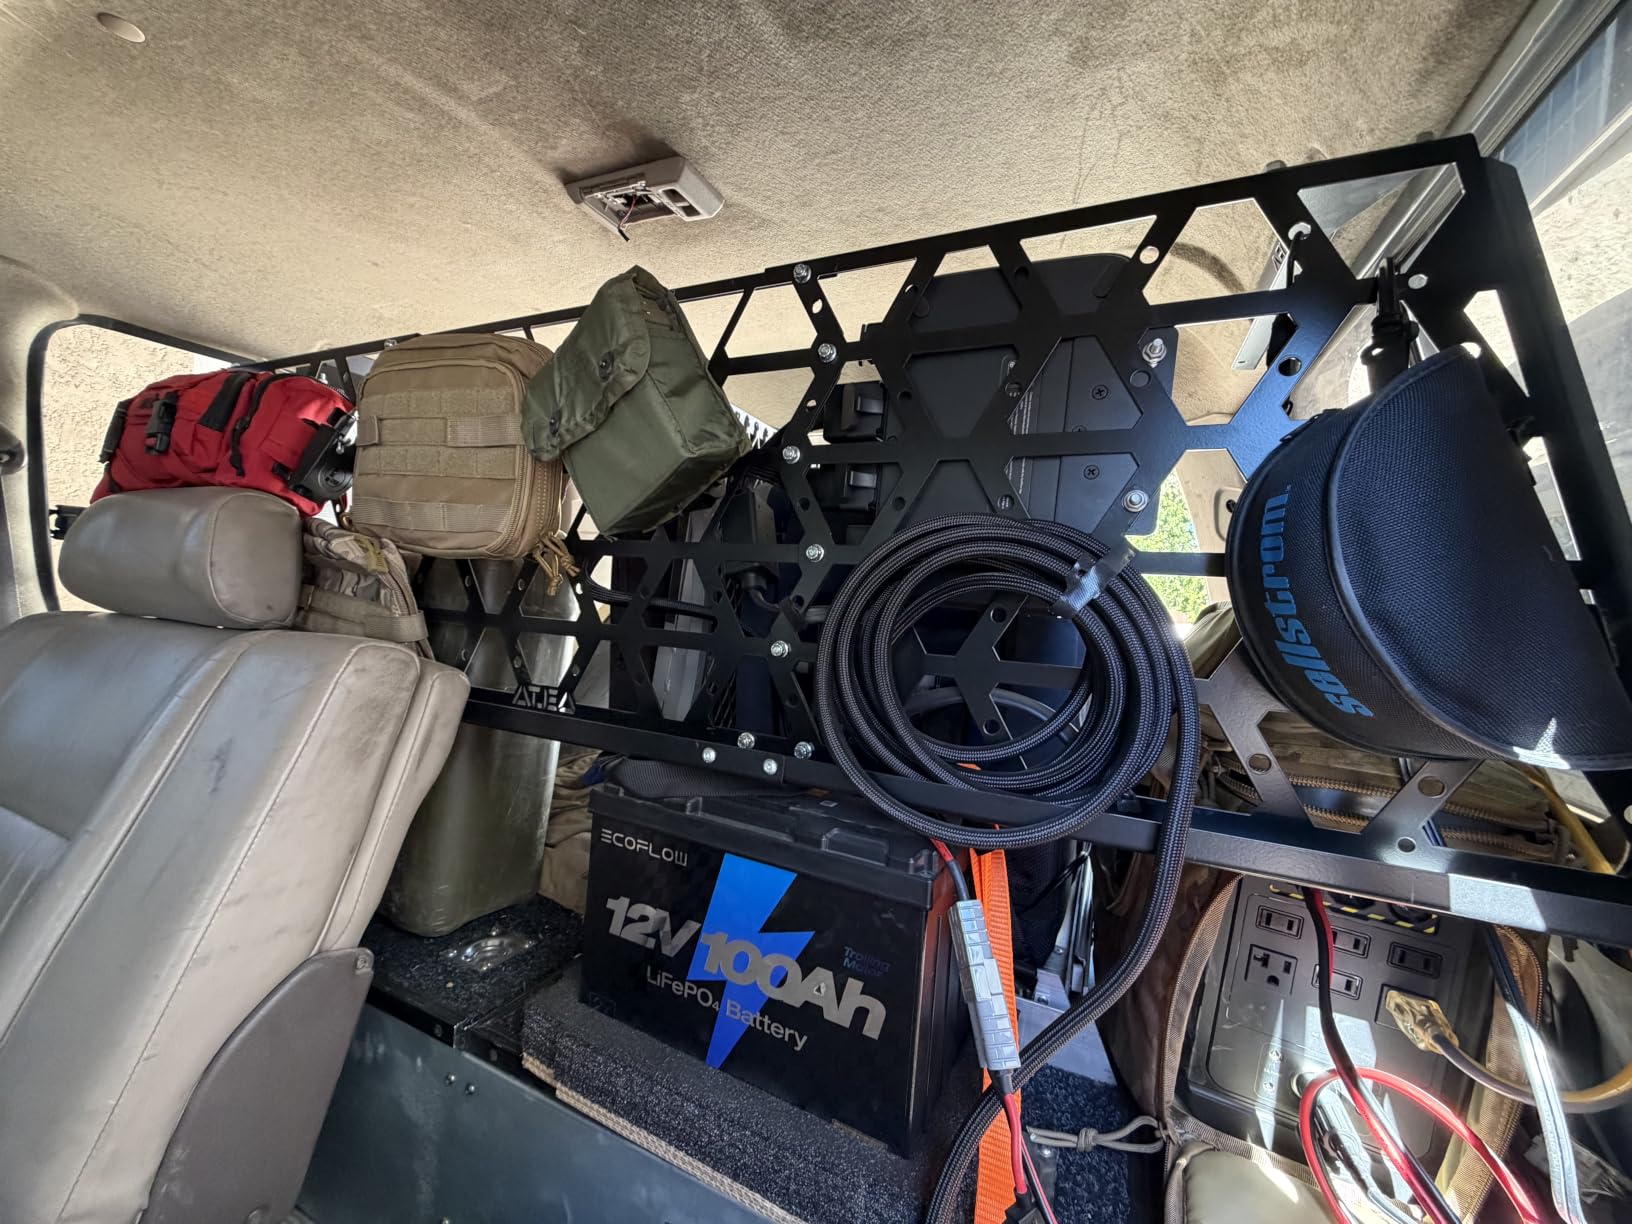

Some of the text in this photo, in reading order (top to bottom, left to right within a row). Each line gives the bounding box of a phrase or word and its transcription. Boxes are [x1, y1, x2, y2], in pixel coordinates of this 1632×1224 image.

[601, 828, 688, 867] ECOFLOW
[606, 895, 886, 1040] 12V 100Ah
[726, 999, 808, 1051] Battery
